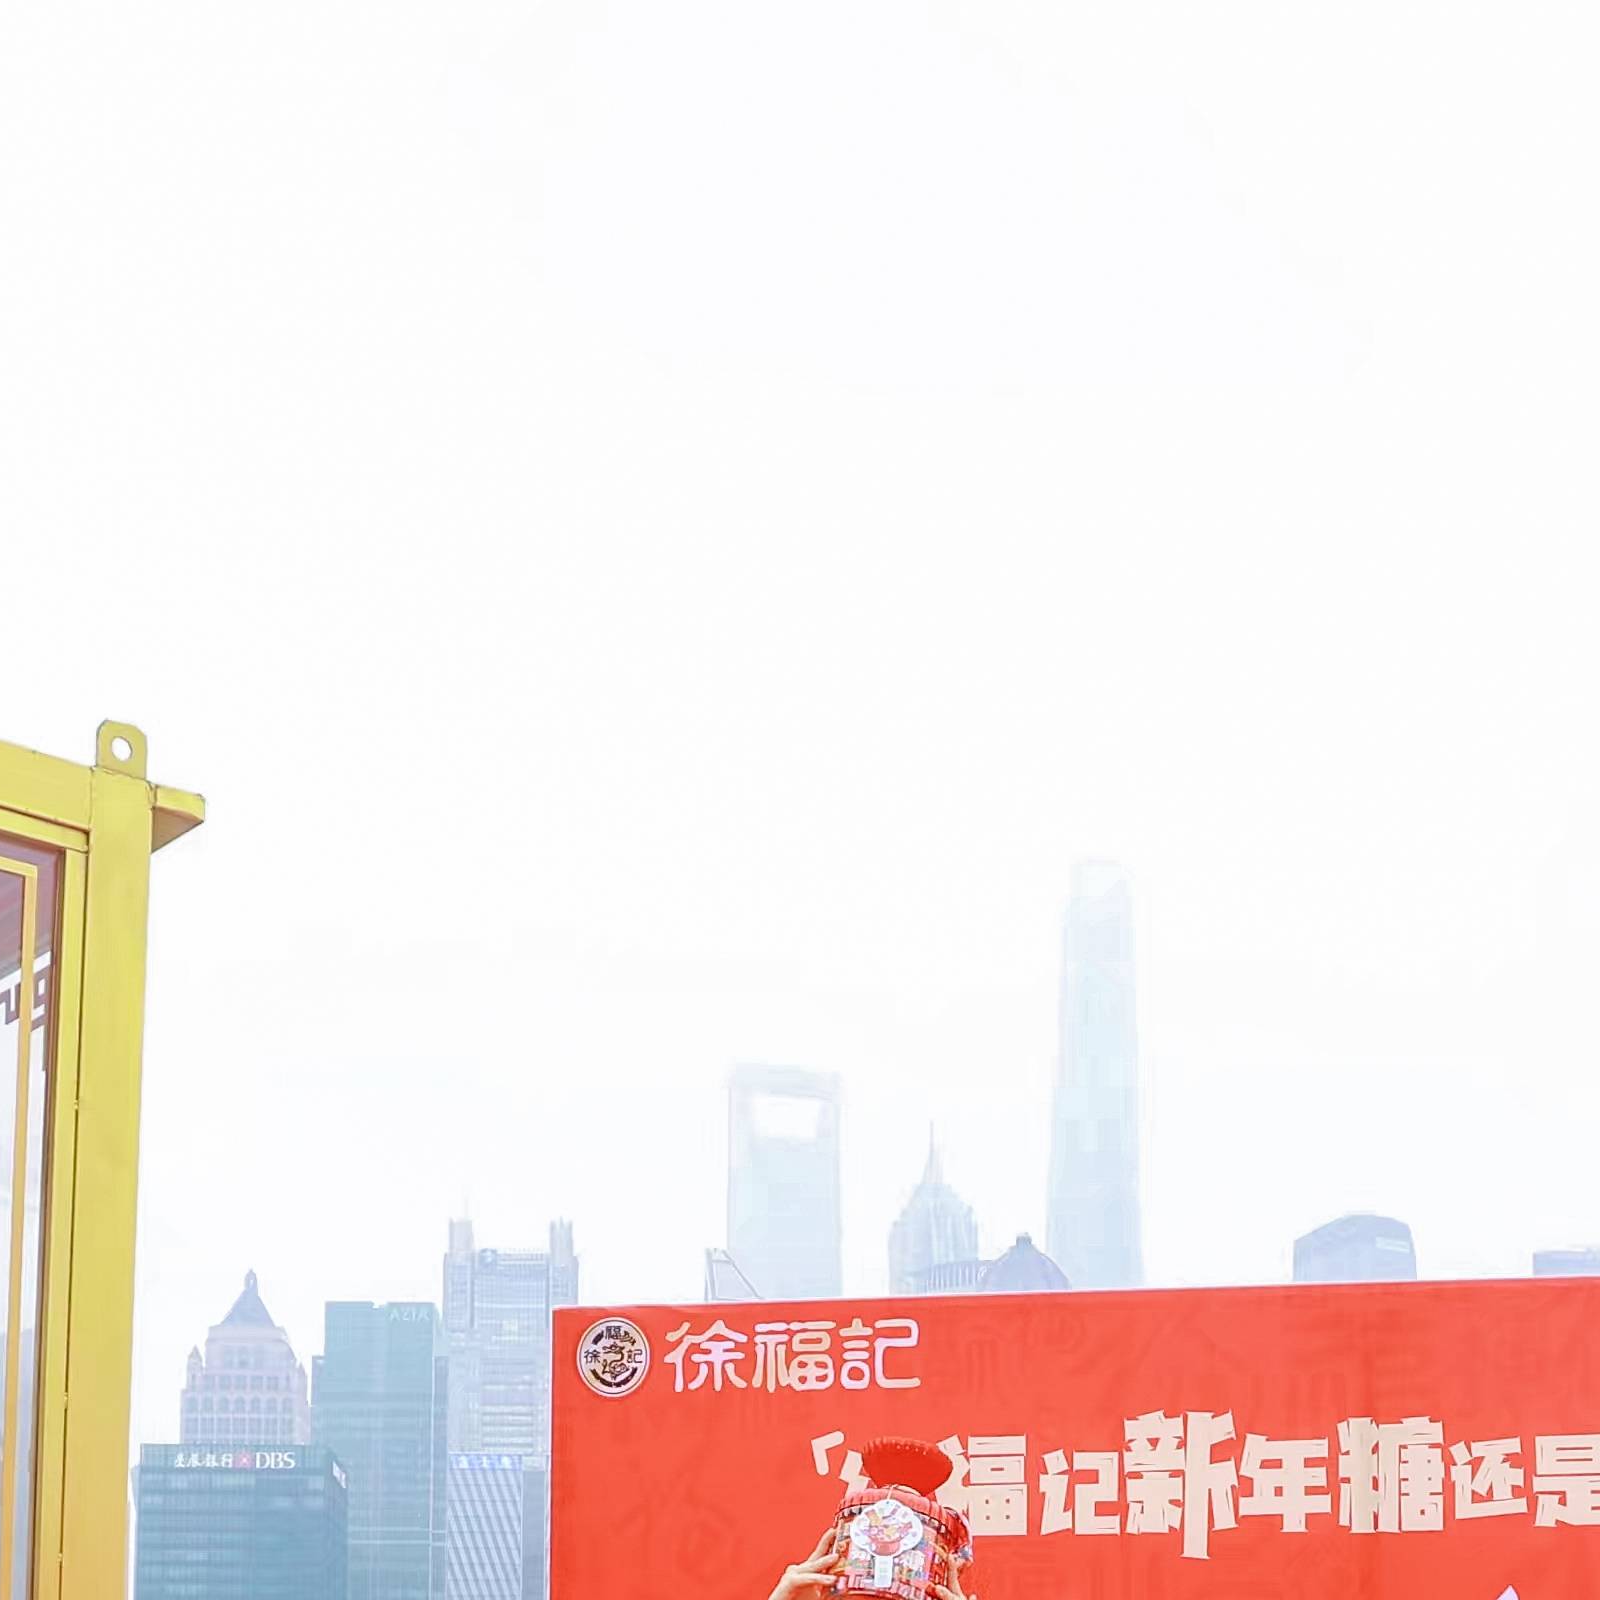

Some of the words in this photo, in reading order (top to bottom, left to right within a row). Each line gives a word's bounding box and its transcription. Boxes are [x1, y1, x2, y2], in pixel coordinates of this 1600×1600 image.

[664, 1319, 920, 1392] 徐福記
[255, 1452, 296, 1469] DBS
